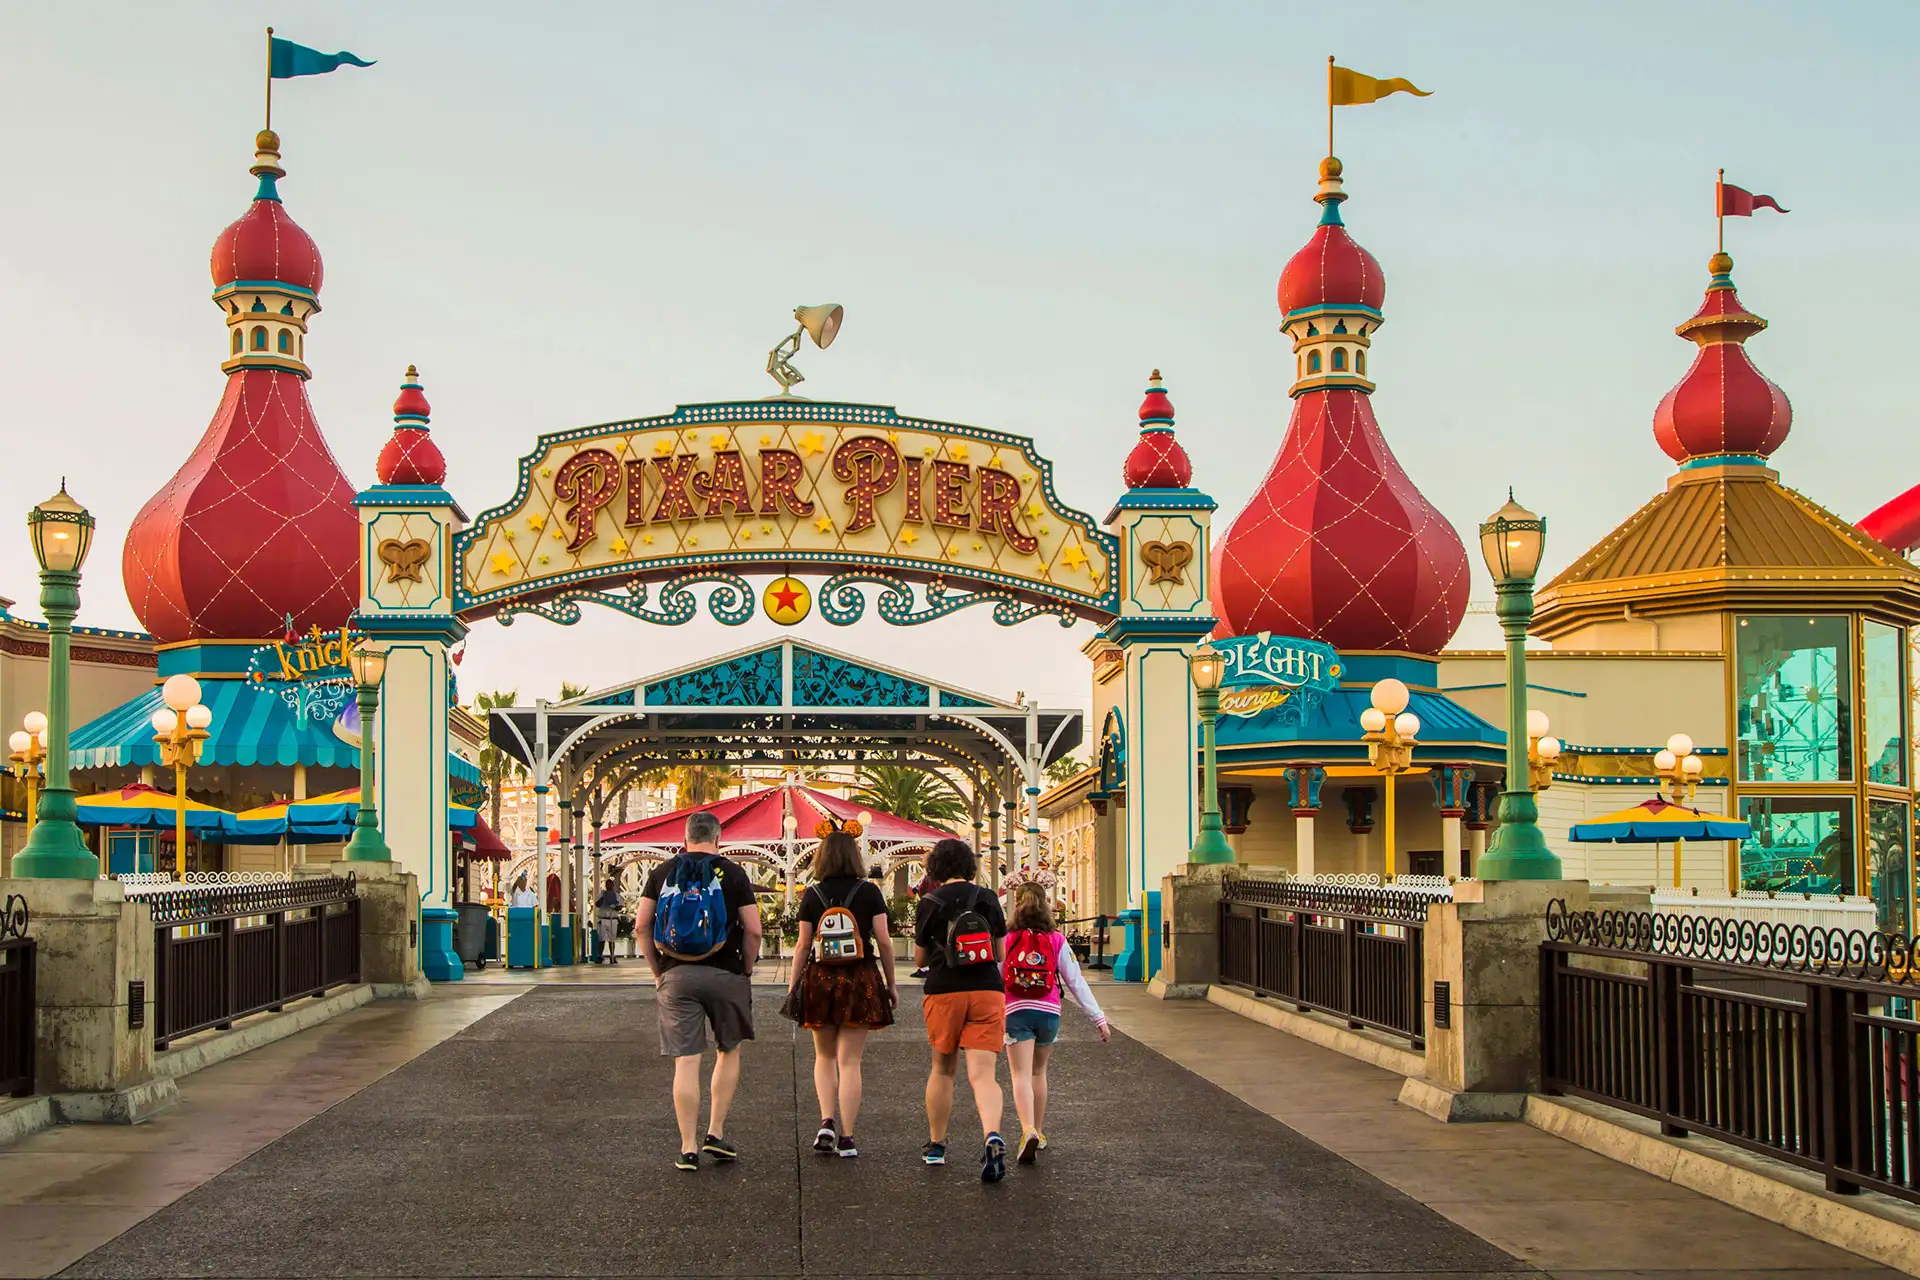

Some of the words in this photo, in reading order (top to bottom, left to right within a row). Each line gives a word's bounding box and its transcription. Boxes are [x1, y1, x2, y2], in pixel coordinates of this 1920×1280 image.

[554, 448, 816, 553] PIXAR
[832, 435, 1038, 555] PIER
[272, 624, 358, 681] knick
[1222, 631, 1325, 686] PLIGHT
